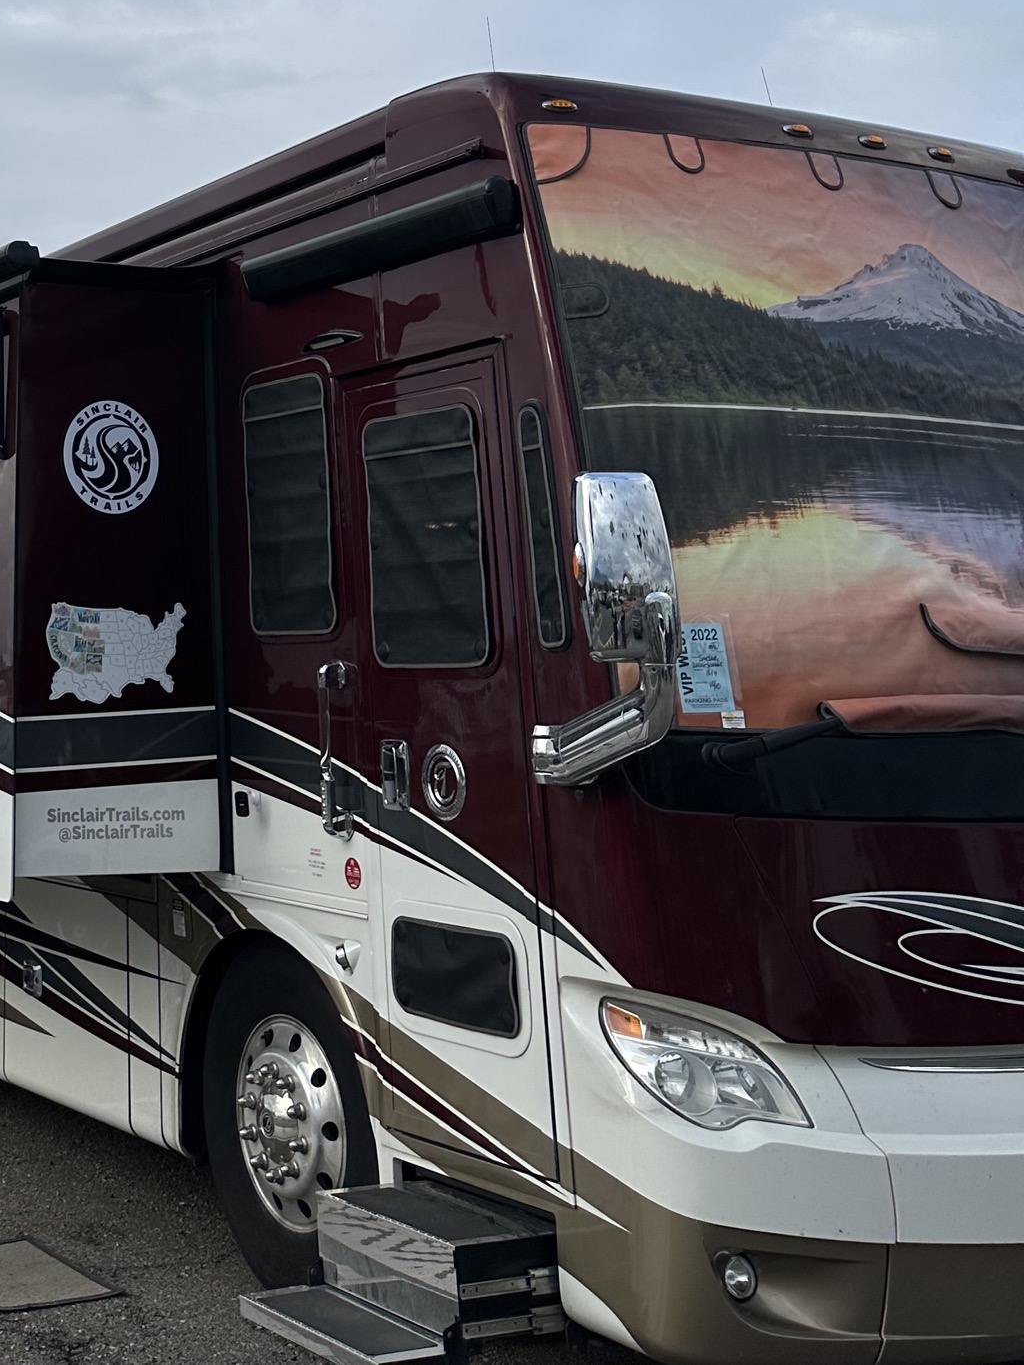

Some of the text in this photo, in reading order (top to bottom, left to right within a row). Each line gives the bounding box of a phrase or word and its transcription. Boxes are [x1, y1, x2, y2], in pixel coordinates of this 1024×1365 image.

[76, 403, 148, 434] SINCLAIR
[79, 486, 144, 511] TRAILS
[690, 628, 718, 641] 2022
[680, 672, 694, 695] VIP
[47, 807, 185, 823] SinclairTrails.com
[59, 823, 174, 843] @SinclairTrails
